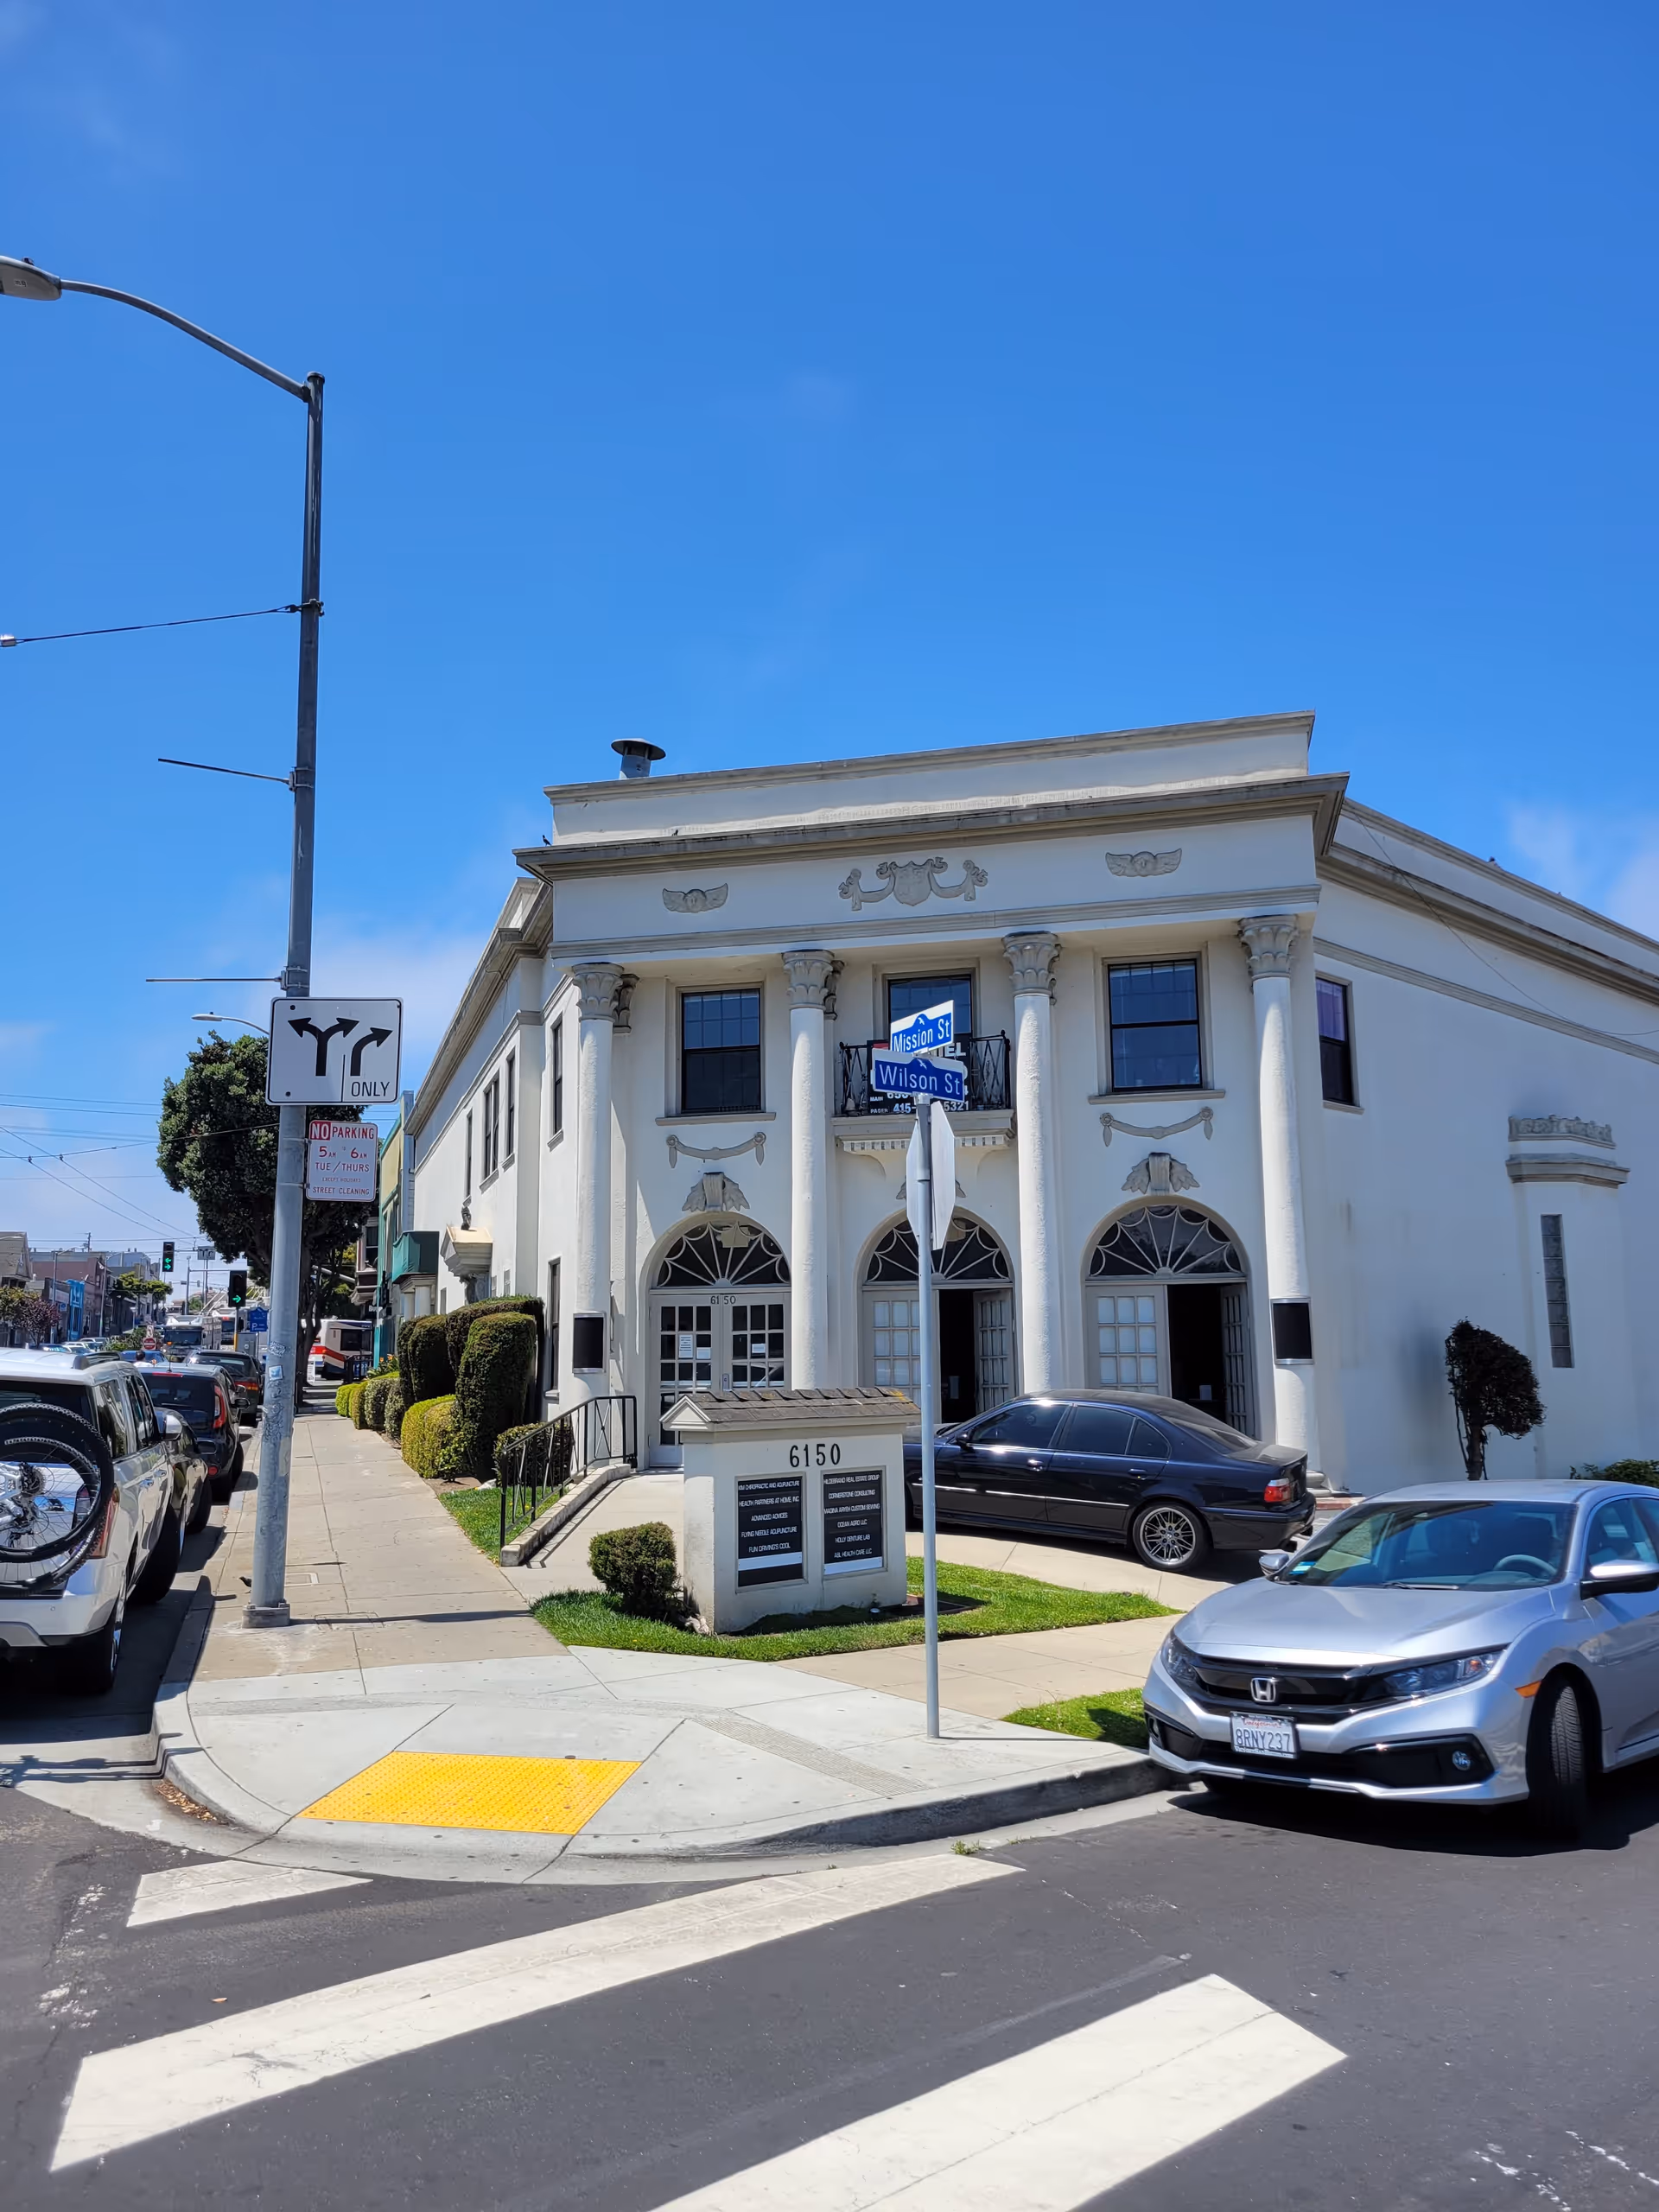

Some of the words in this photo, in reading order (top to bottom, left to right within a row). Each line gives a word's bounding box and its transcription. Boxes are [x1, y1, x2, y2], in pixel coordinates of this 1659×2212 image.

[893, 1028, 933, 1052] Mission
[938, 1018, 950, 1040] St
[879, 1064, 938, 1091] Wilson
[944, 1072, 961, 1096] St
[351, 1081, 391, 1097] ONLY
[311, 1122, 329, 1140] NO
[332, 1126, 375, 1140] PARKING
[338, 1187, 370, 1196] CLEANING
[788, 1442, 842, 1468] 6150
[855, 1489, 876, 1497] CONSULTING
[739, 1499, 753, 1508] HEALTH
[754, 1497, 774, 1506] PARTNERS
[751, 1513, 772, 1522] ADVANCED
[770, 1525, 798, 1535] ACUPUNCTURE
[1235, 1727, 1291, 1752] 8RNY237
